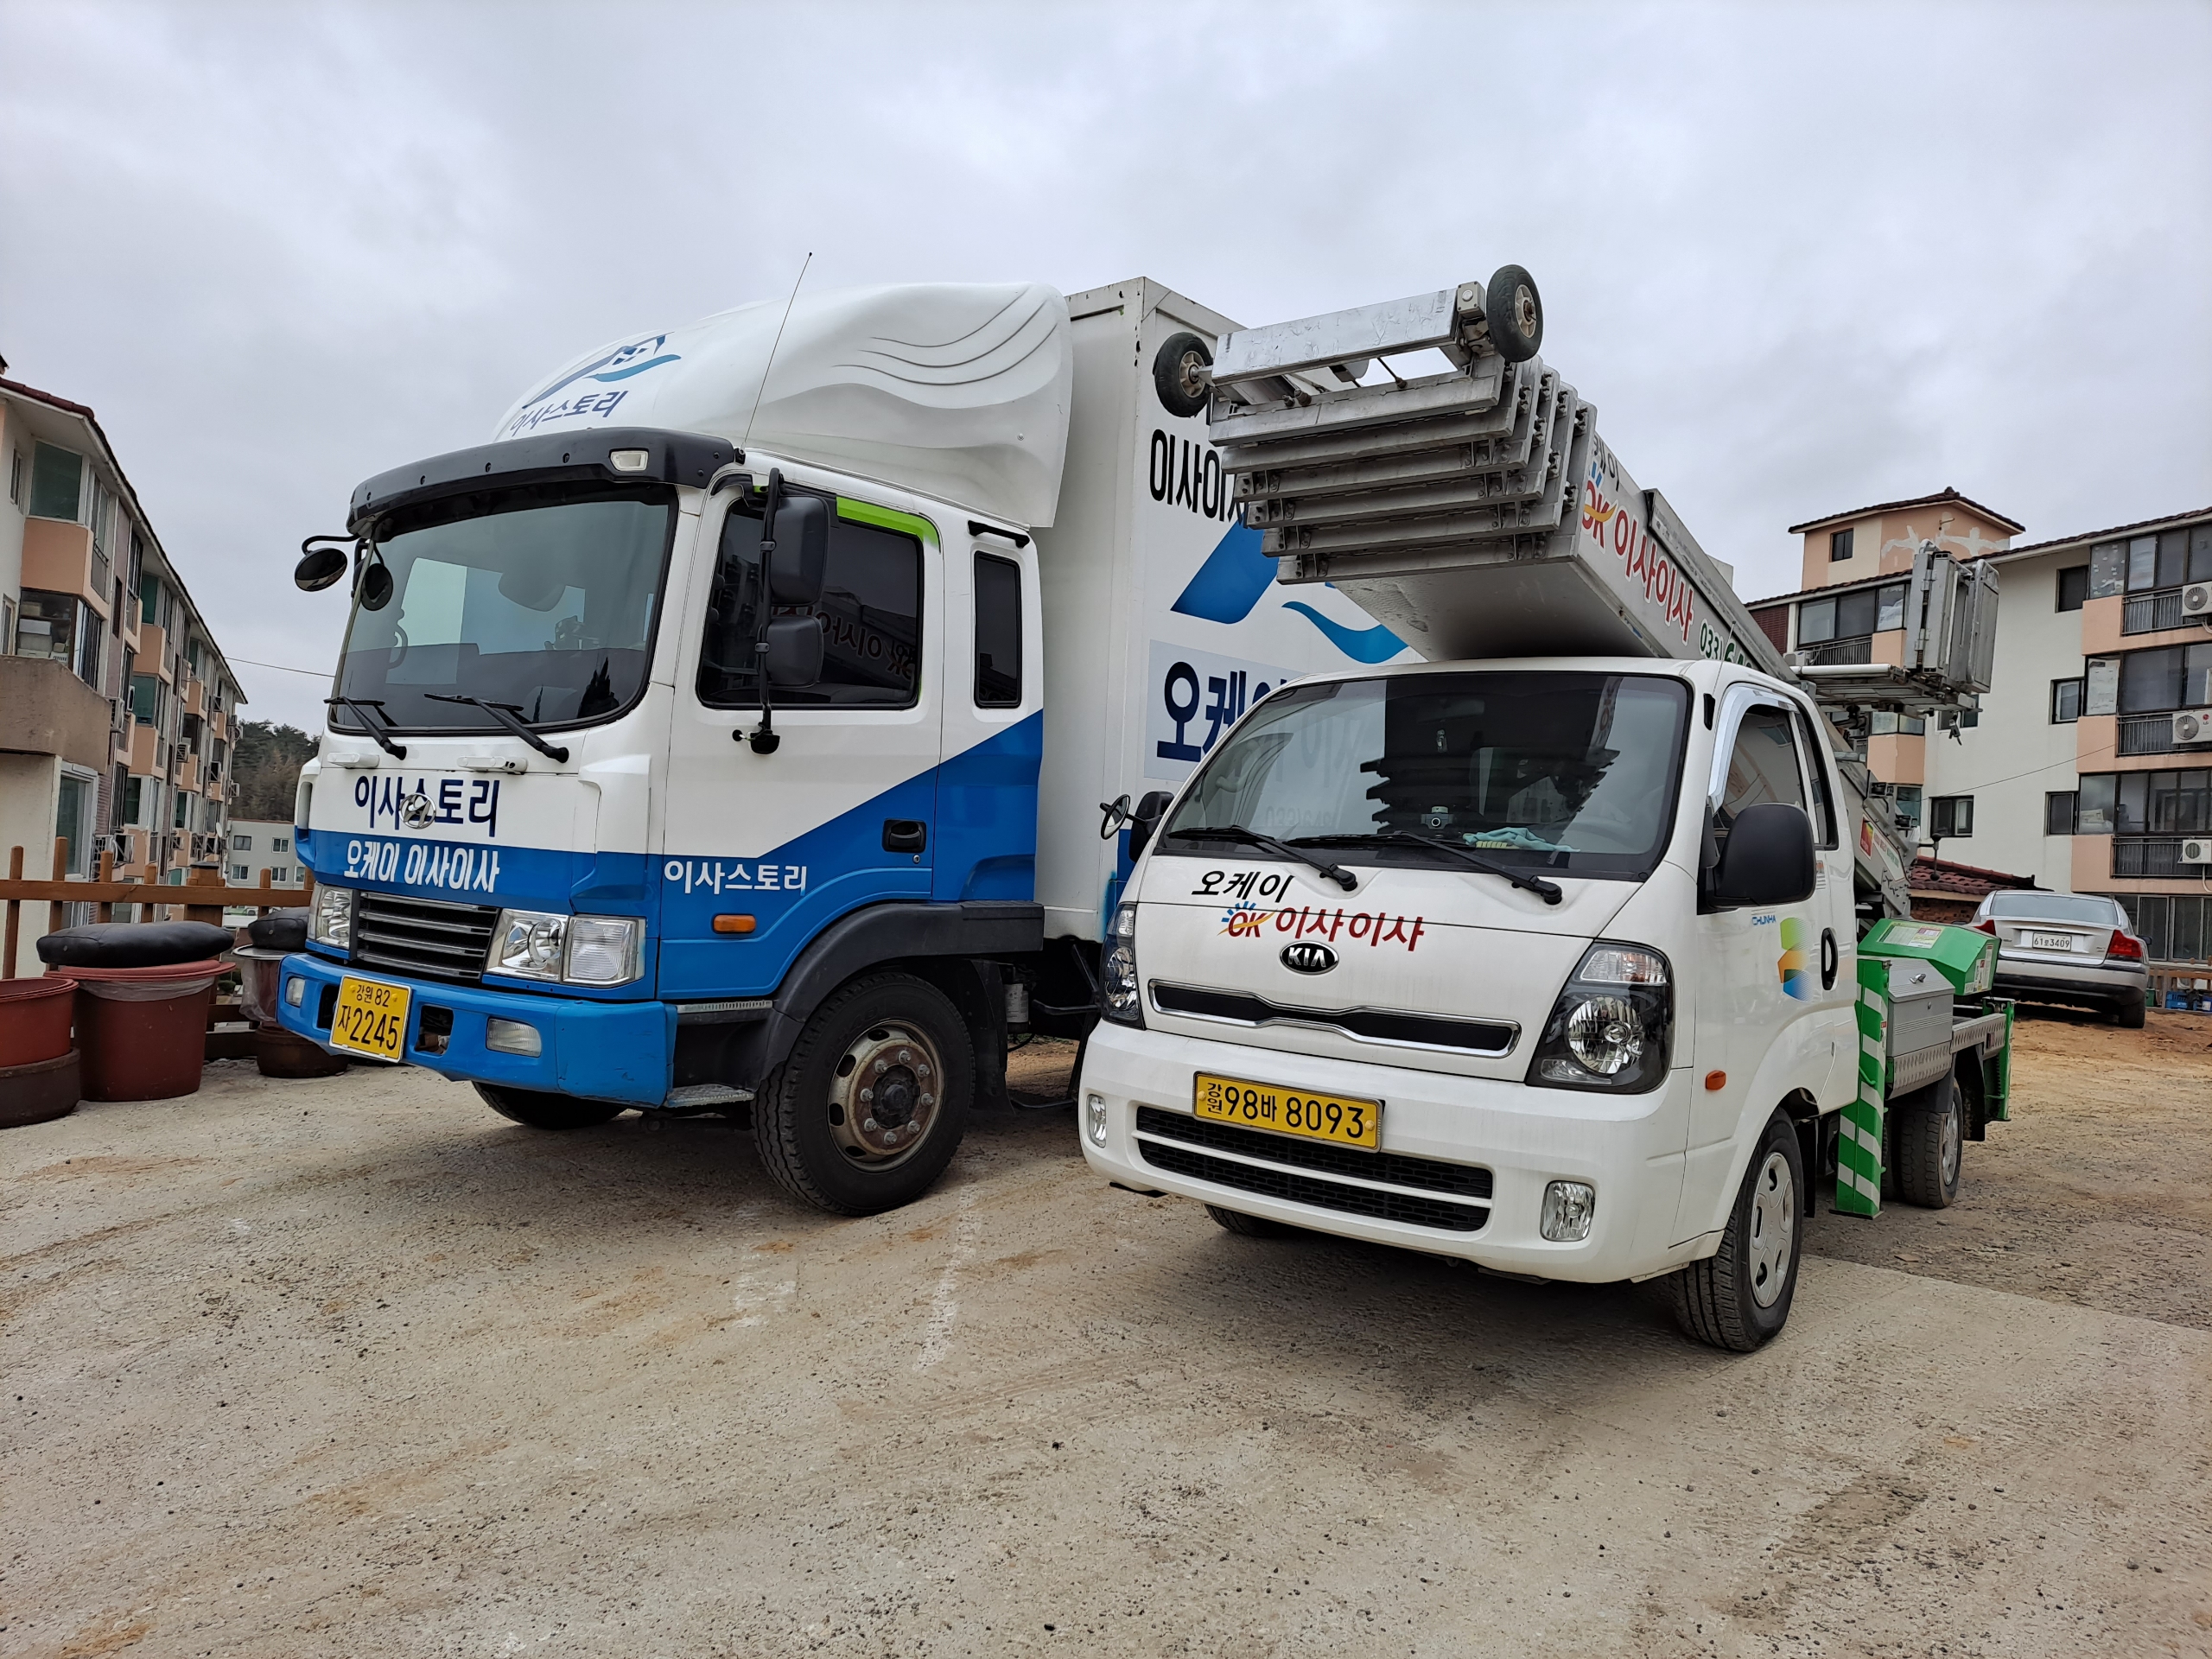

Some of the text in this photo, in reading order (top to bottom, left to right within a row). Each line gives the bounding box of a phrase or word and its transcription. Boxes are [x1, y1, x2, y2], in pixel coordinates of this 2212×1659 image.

[510, 391, 628, 437] 이사스토리
[1615, 510, 1694, 643] 이사이사
[344, 840, 500, 893] 오케이 이사이사
[664, 861, 807, 896] 이사스토리
[1192, 870, 1294, 903] 오케이
[1228, 906, 1425, 951] OK 이사이사
[1287, 946, 1326, 968] KIA
[374, 988, 391, 1007] 82
[1286, 1096, 1363, 1139] 8093
